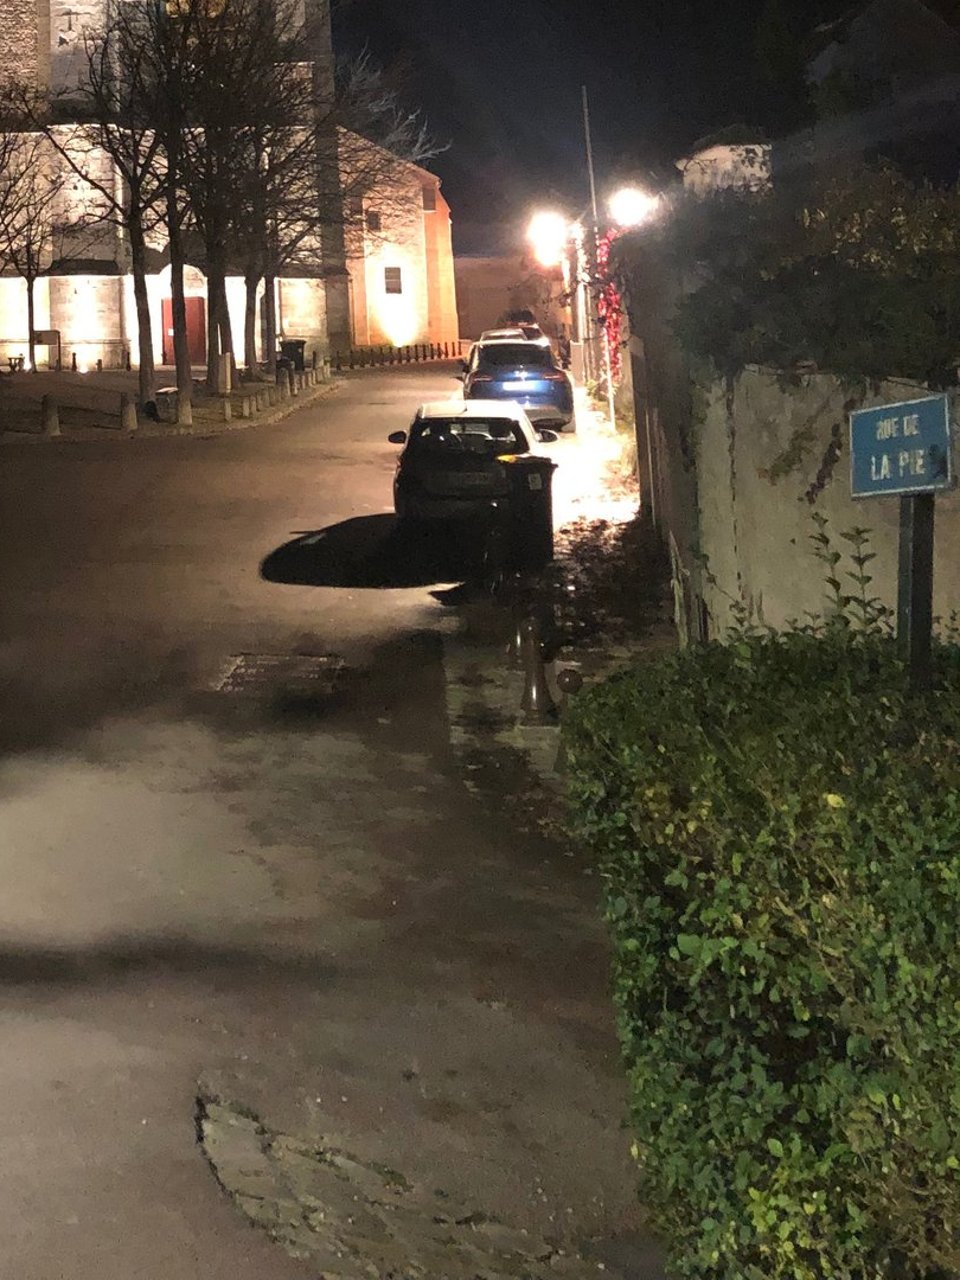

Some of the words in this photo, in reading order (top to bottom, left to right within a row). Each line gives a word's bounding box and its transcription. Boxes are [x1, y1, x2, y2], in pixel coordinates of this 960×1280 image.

[877, 417, 899, 440] RUE
[903, 415, 920, 436] DE
[871, 454, 891, 481] LA
[898, 449, 926, 478] PIE
